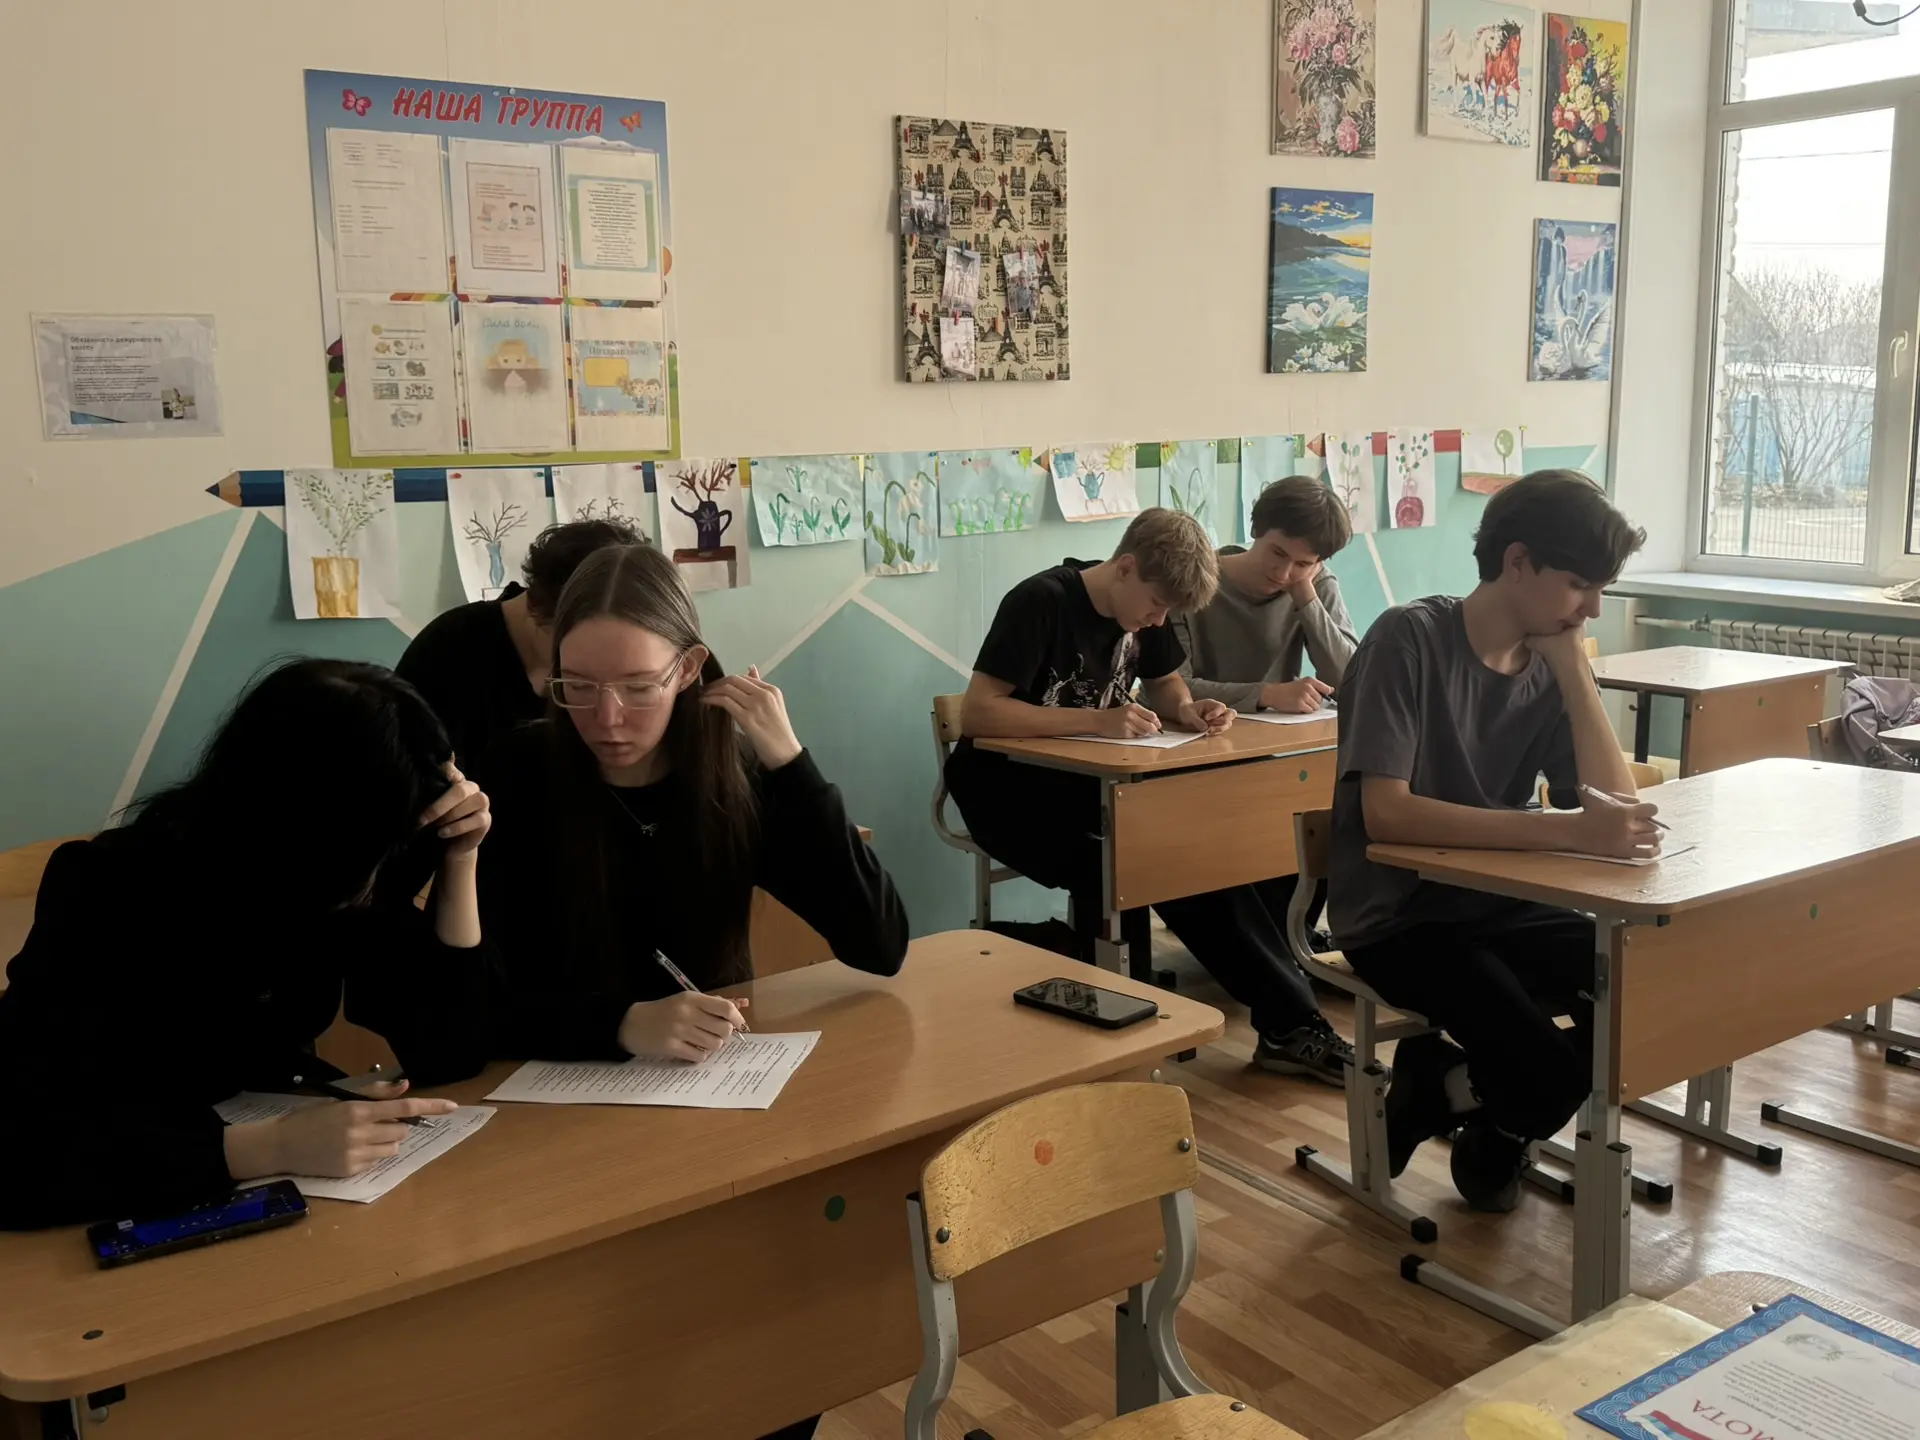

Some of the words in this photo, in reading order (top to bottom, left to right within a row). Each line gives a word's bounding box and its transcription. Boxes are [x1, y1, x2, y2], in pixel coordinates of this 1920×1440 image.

[392, 87, 483, 124] НАША
[497, 95, 604, 134] ГРУППА
[1297, 1042, 1324, 1060] N
